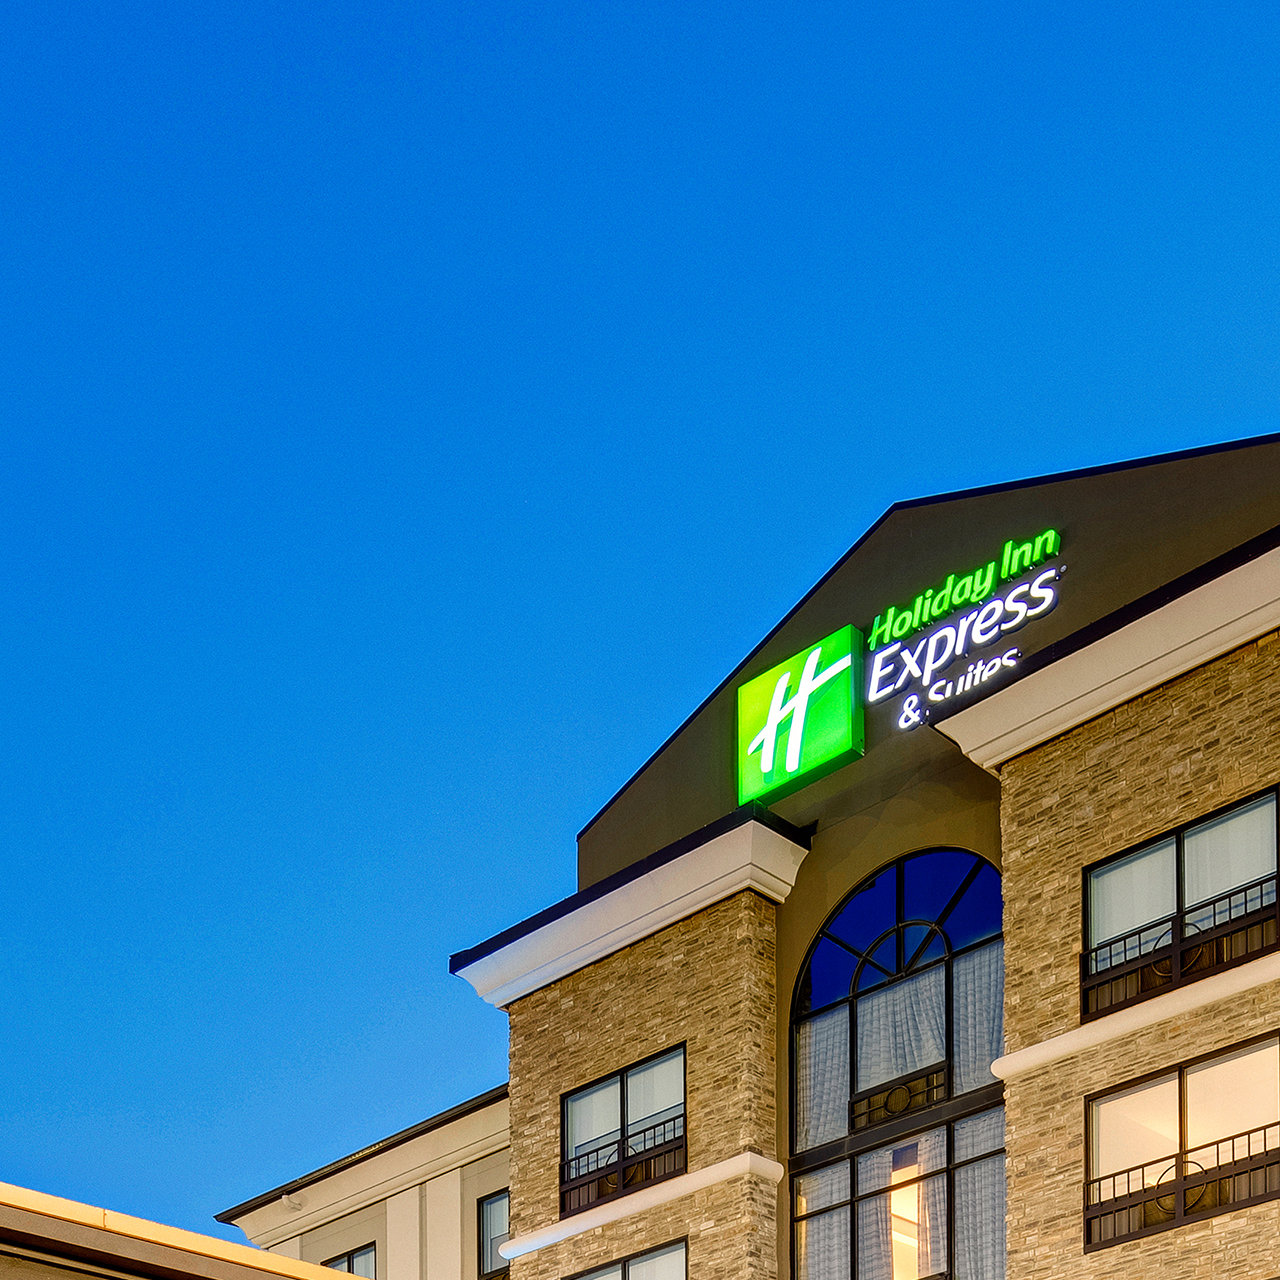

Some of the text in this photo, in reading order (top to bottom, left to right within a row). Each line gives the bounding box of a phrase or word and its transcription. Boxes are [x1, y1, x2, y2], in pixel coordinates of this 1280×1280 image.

[867, 528, 1061, 652] Holiday Inn
[867, 567, 1057, 703] Express
[898, 693, 922, 730] &
